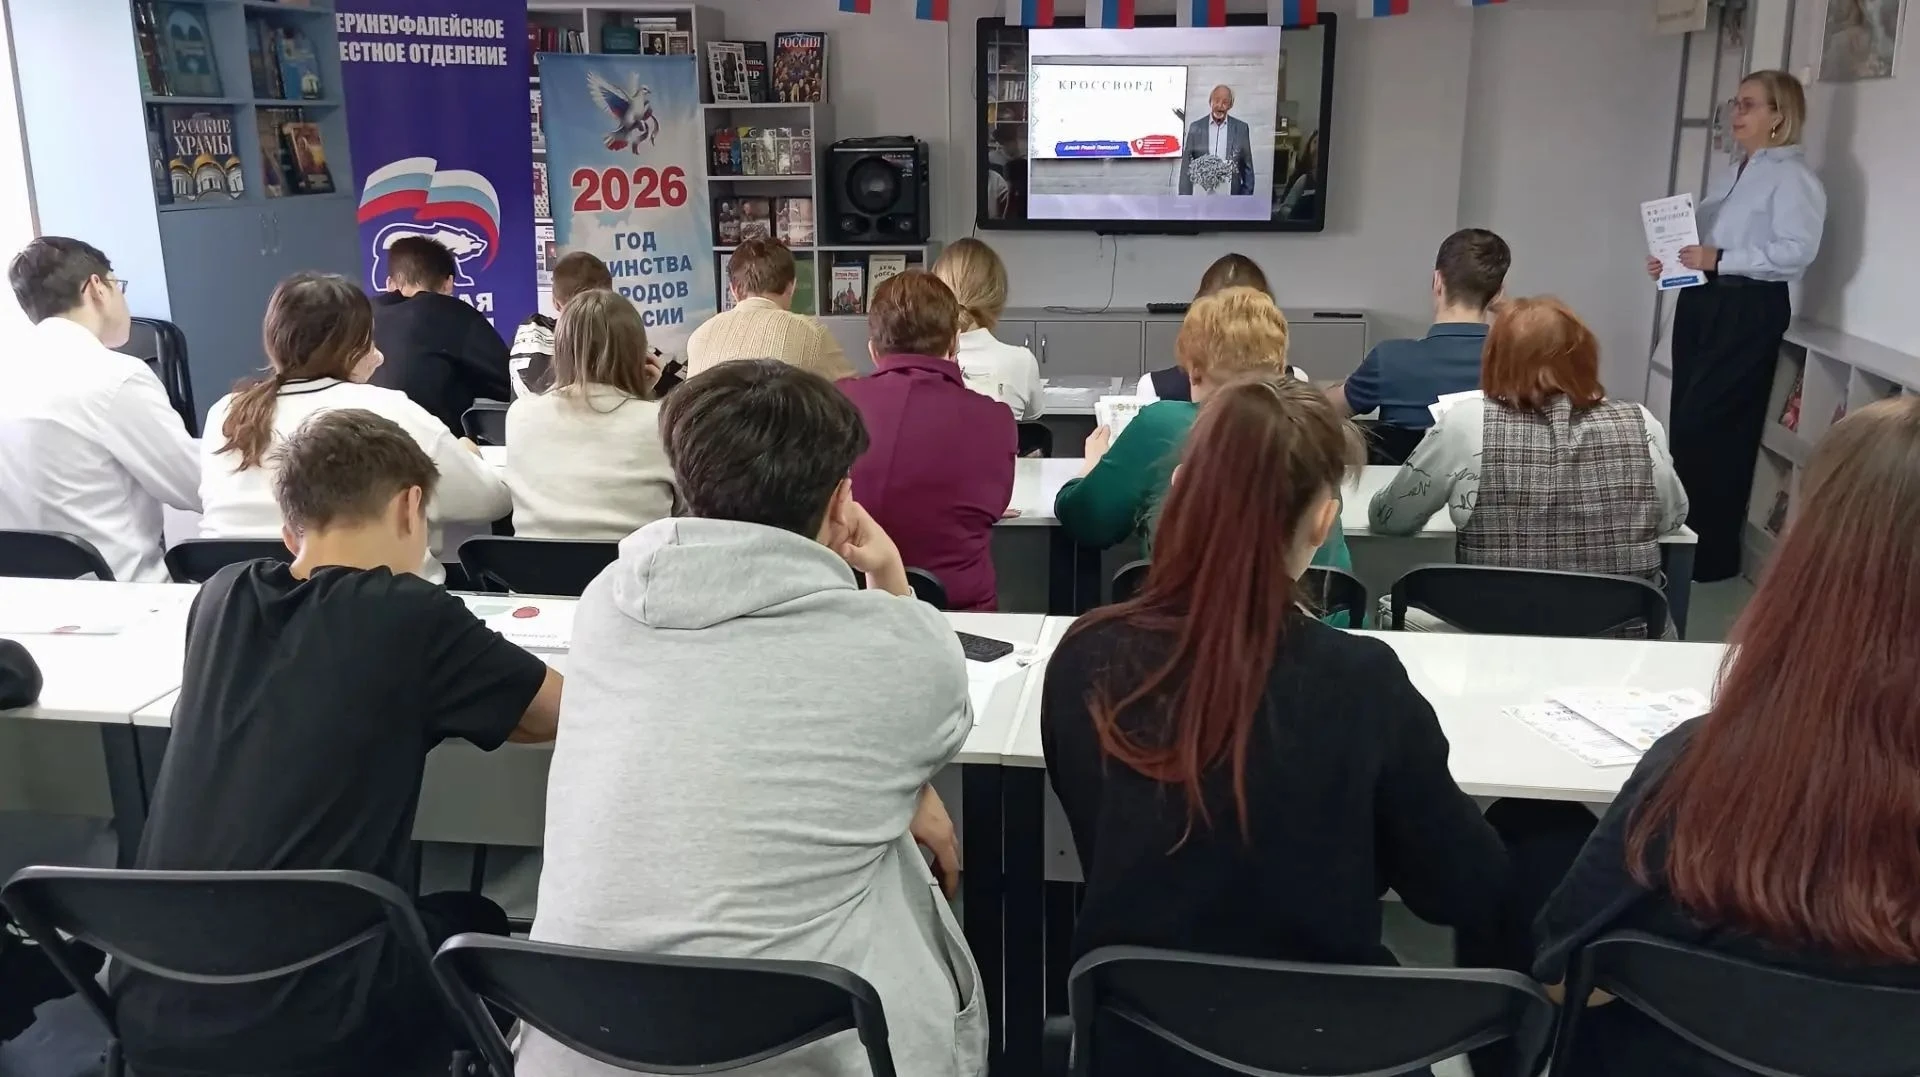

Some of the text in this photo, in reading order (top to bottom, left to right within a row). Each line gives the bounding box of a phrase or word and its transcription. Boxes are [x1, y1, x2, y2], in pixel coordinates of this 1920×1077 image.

[335, 13, 504, 39] ЕРХНЕУФАЛЕЙСКОЕ
[339, 41, 508, 66] ЕСТНОЕ ОТДЕЛЕНИЕ
[1058, 80, 1153, 92] КРОССВОРД
[172, 119, 232, 134] РУССКИЕ
[174, 135, 233, 156] ХРАМЫ
[571, 166, 688, 212] 2026
[615, 231, 657, 251] ГОД
[607, 255, 692, 278] ИНСТВА
[873, 271, 896, 279] РОССИ
[618, 281, 689, 304] РОДОВ
[642, 307, 684, 328] СИИ
